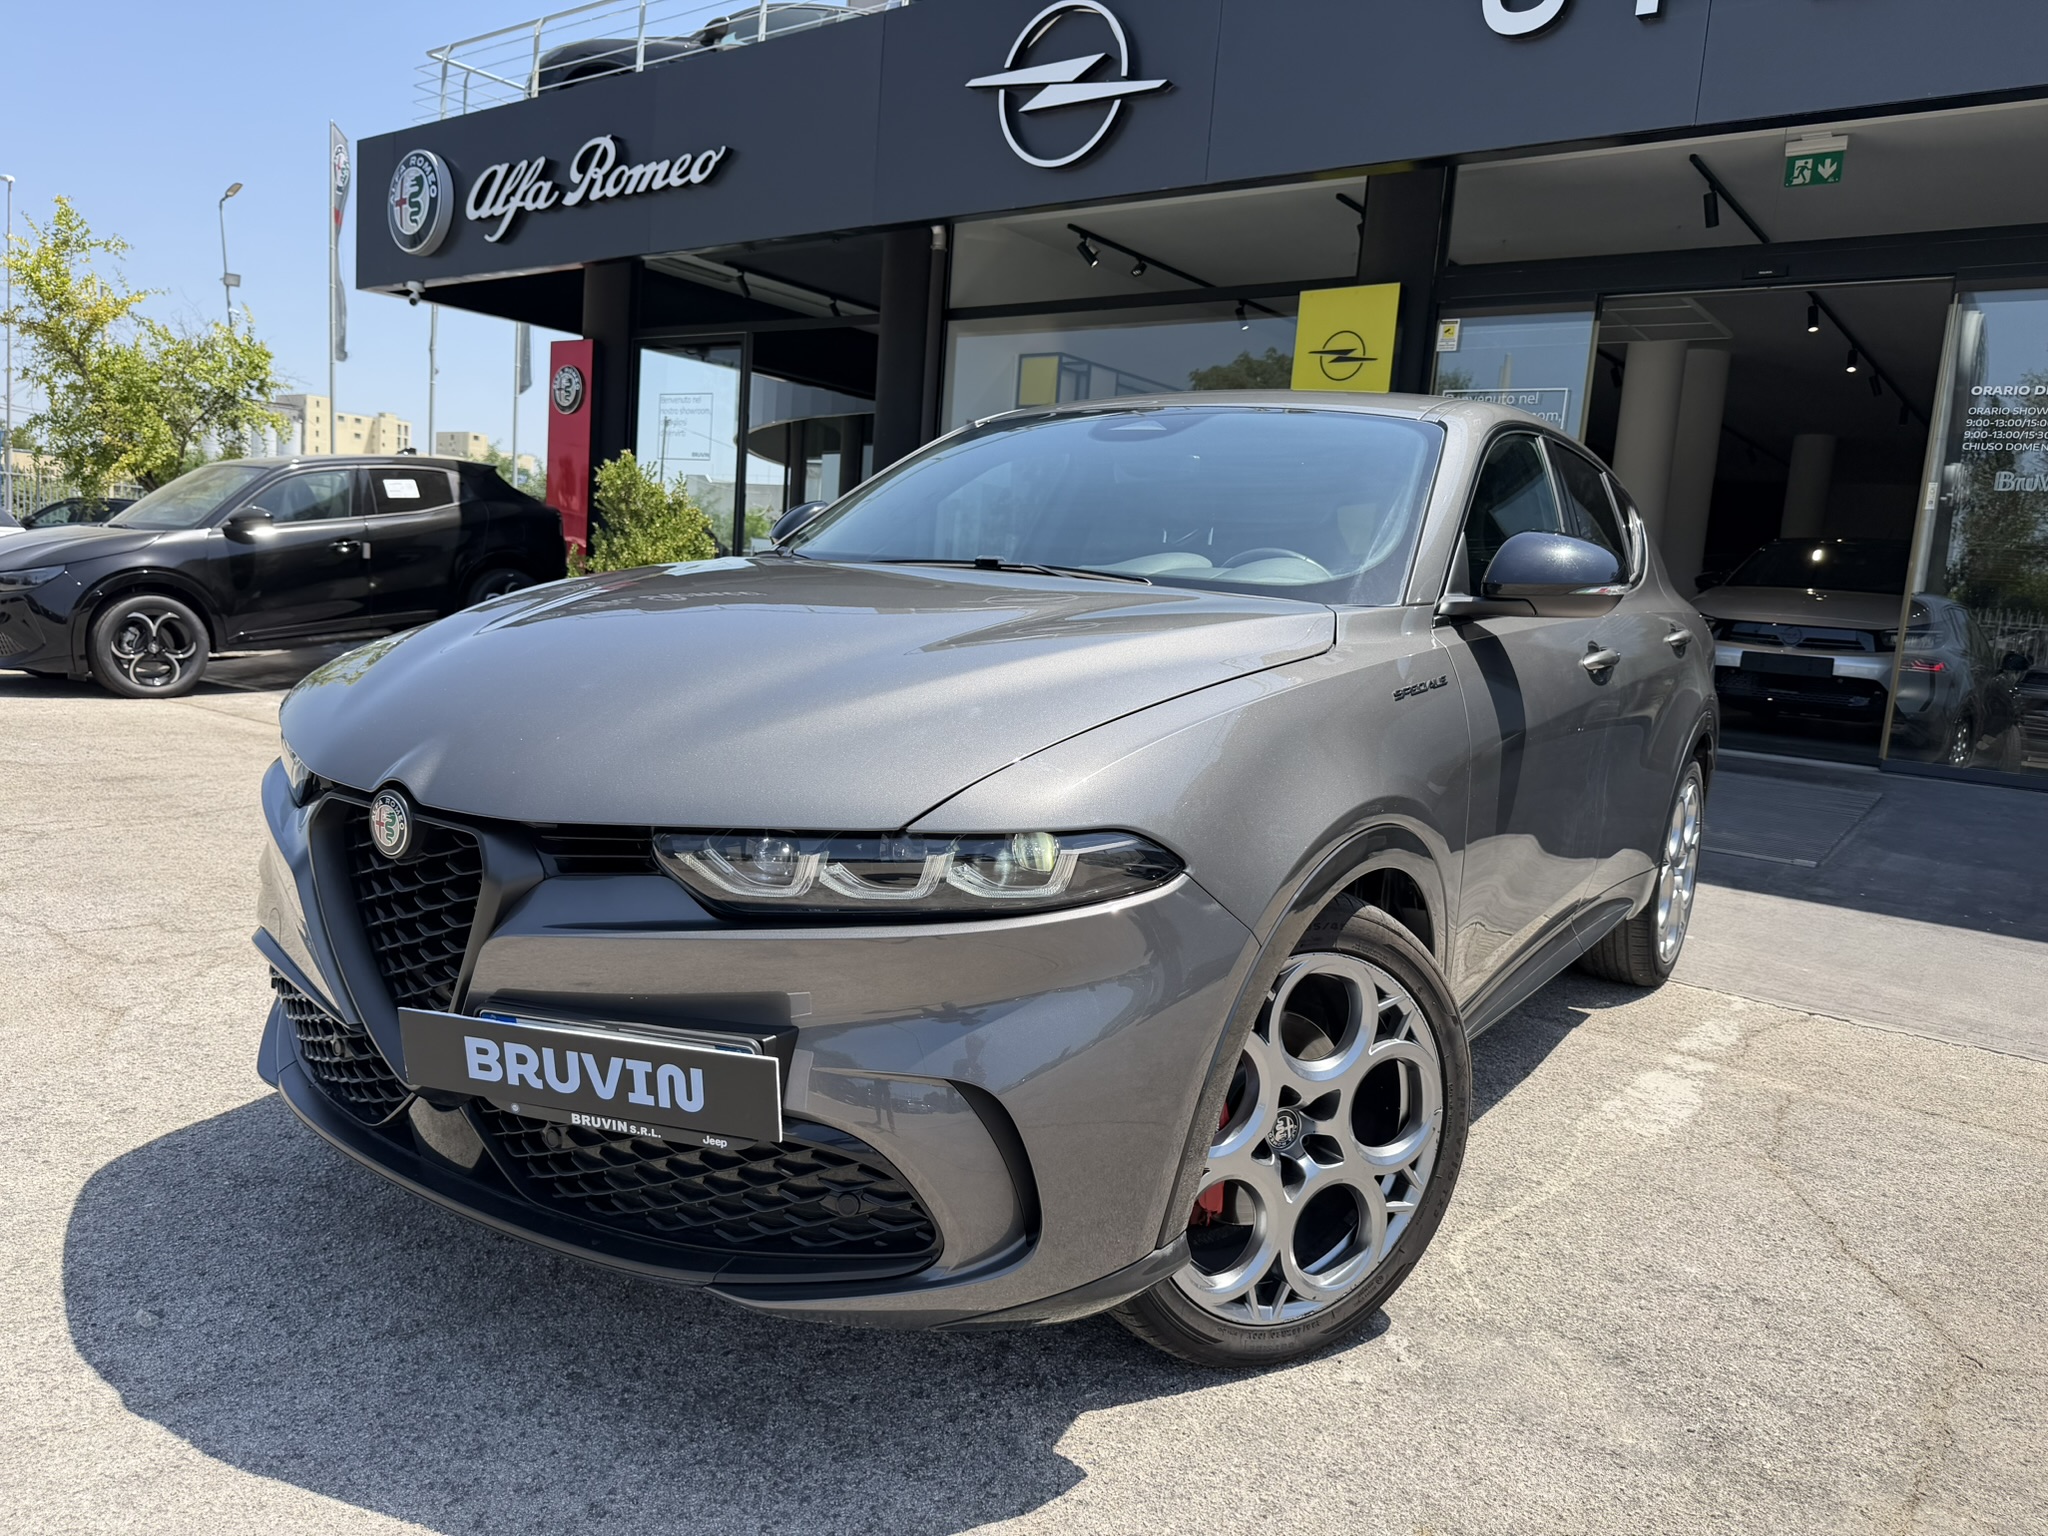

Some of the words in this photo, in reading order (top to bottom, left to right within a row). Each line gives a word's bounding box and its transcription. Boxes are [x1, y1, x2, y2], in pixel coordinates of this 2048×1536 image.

[409, 156, 437, 198] ROMEO
[466, 156, 559, 242] Alfa
[562, 134, 726, 206] Romeo
[1519, 391, 1539, 405] nel
[1971, 385, 2030, 396] ORARIO
[2034, 385, 2048, 396] D
[1968, 407, 2010, 415] ORARIO
[2012, 407, 2048, 415] SHOW
[1966, 418, 2048, 428] 9:00-13:00/15:0
[1962, 442, 2003, 451] CHIUSO
[2005, 442, 2048, 451] DOMEN
[1391, 674, 1448, 702] SPECIALE
[384, 797, 405, 831] ROMEO
[464, 1035, 705, 1113] BRUVIN
[571, 1112, 628, 1133] BRUVIN
[629, 1125, 662, 1139] S.R.L.
[702, 1135, 728, 1149] Jeep
